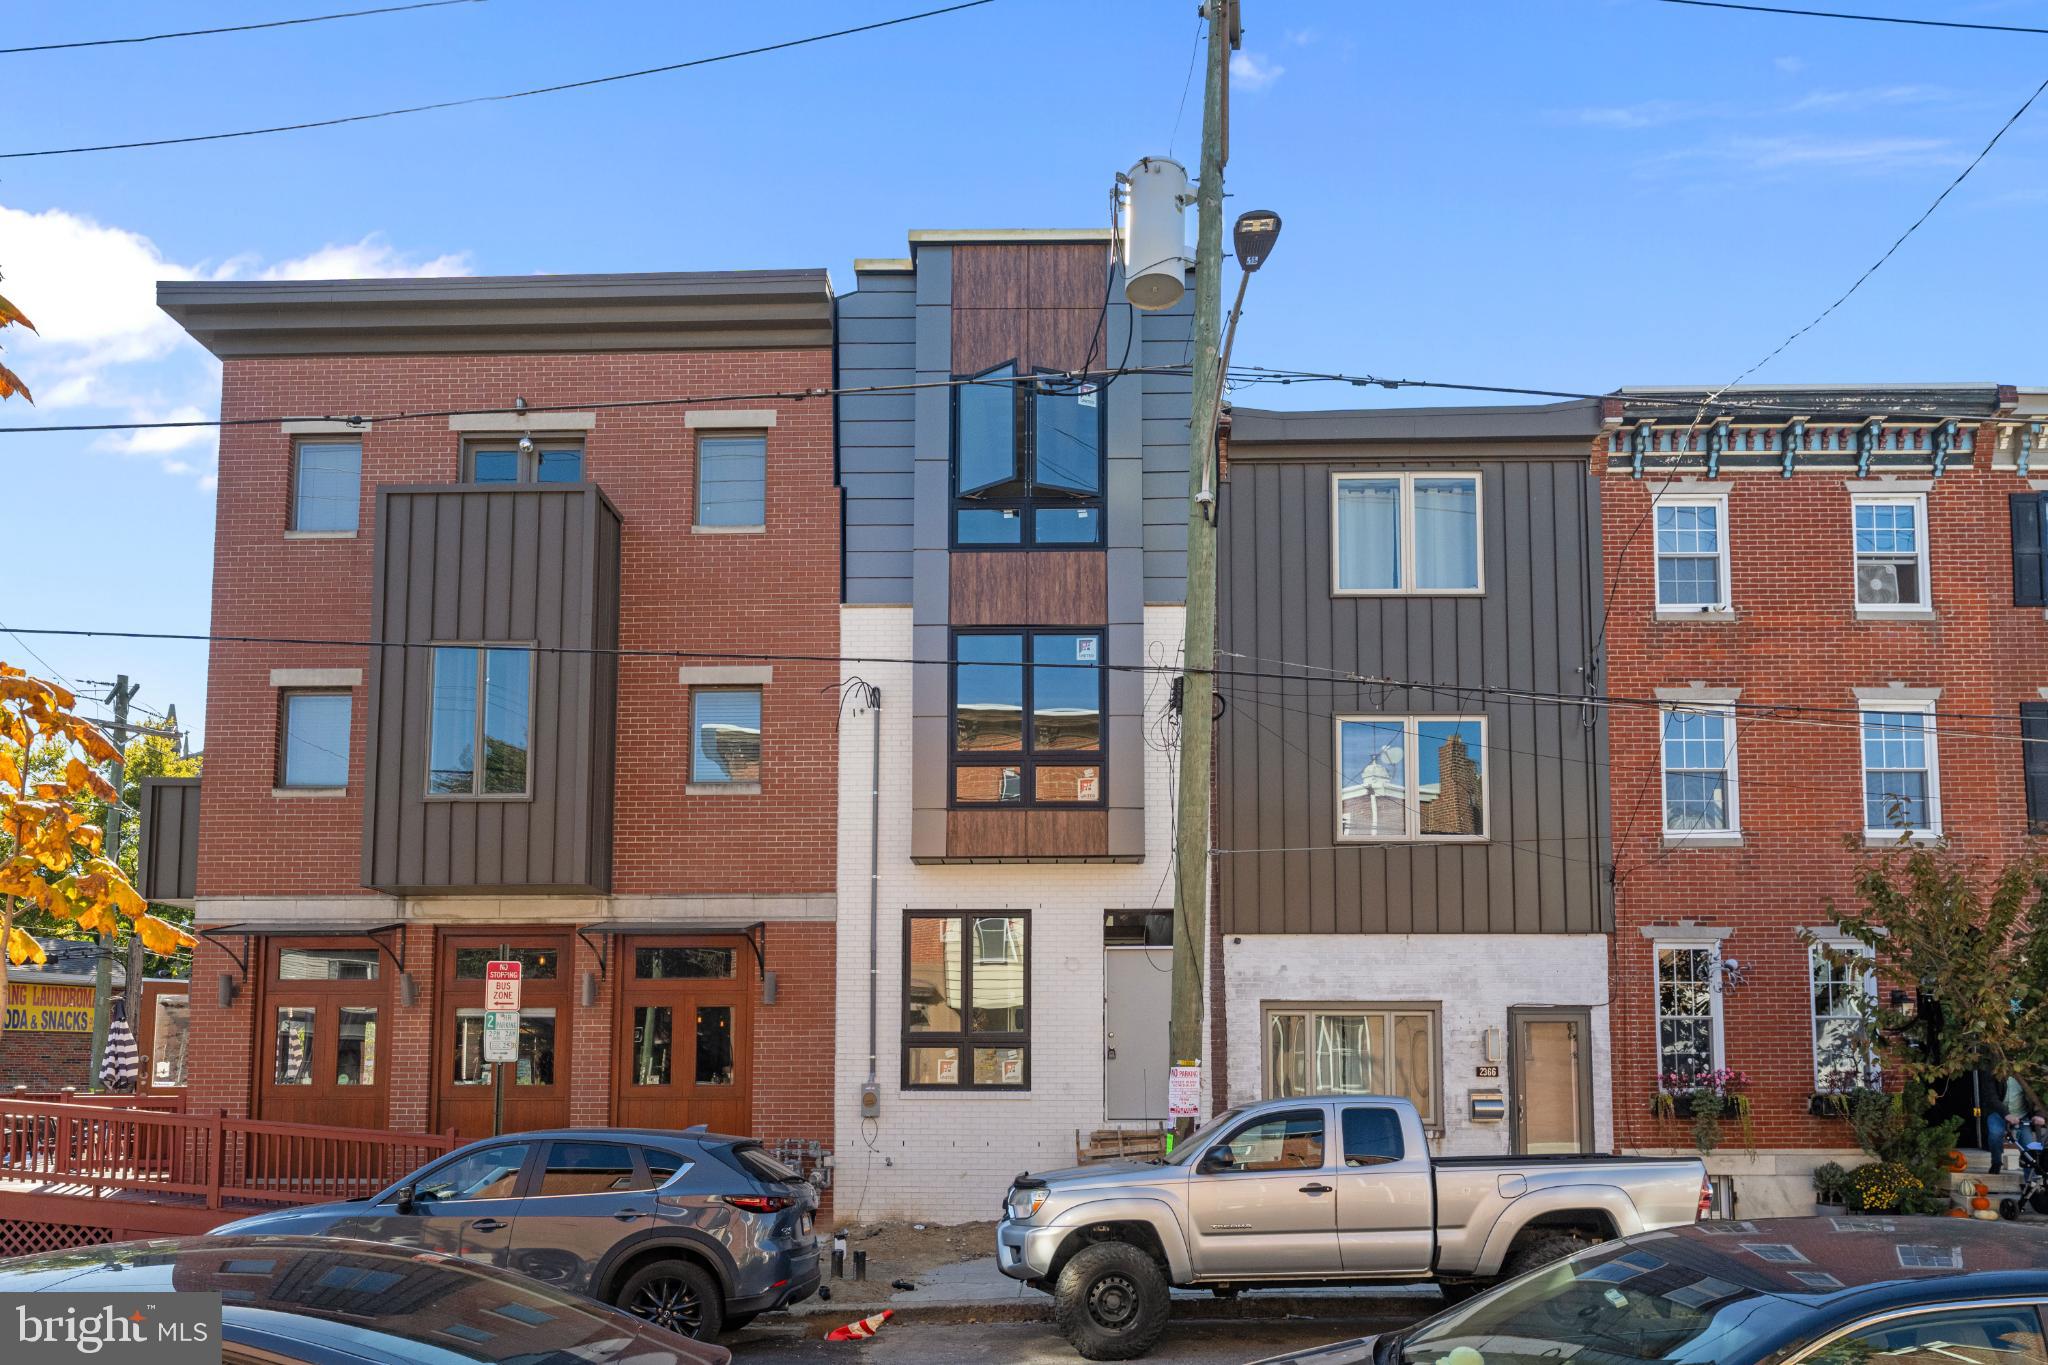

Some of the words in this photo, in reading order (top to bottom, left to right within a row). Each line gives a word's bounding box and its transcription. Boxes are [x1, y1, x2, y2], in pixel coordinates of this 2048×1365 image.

[30, 1014, 38, 1029] &
[41, 1010, 88, 1031] SNACKS
[488, 1015, 494, 1028] 2
[1480, 1067, 1496, 1076] 2366
